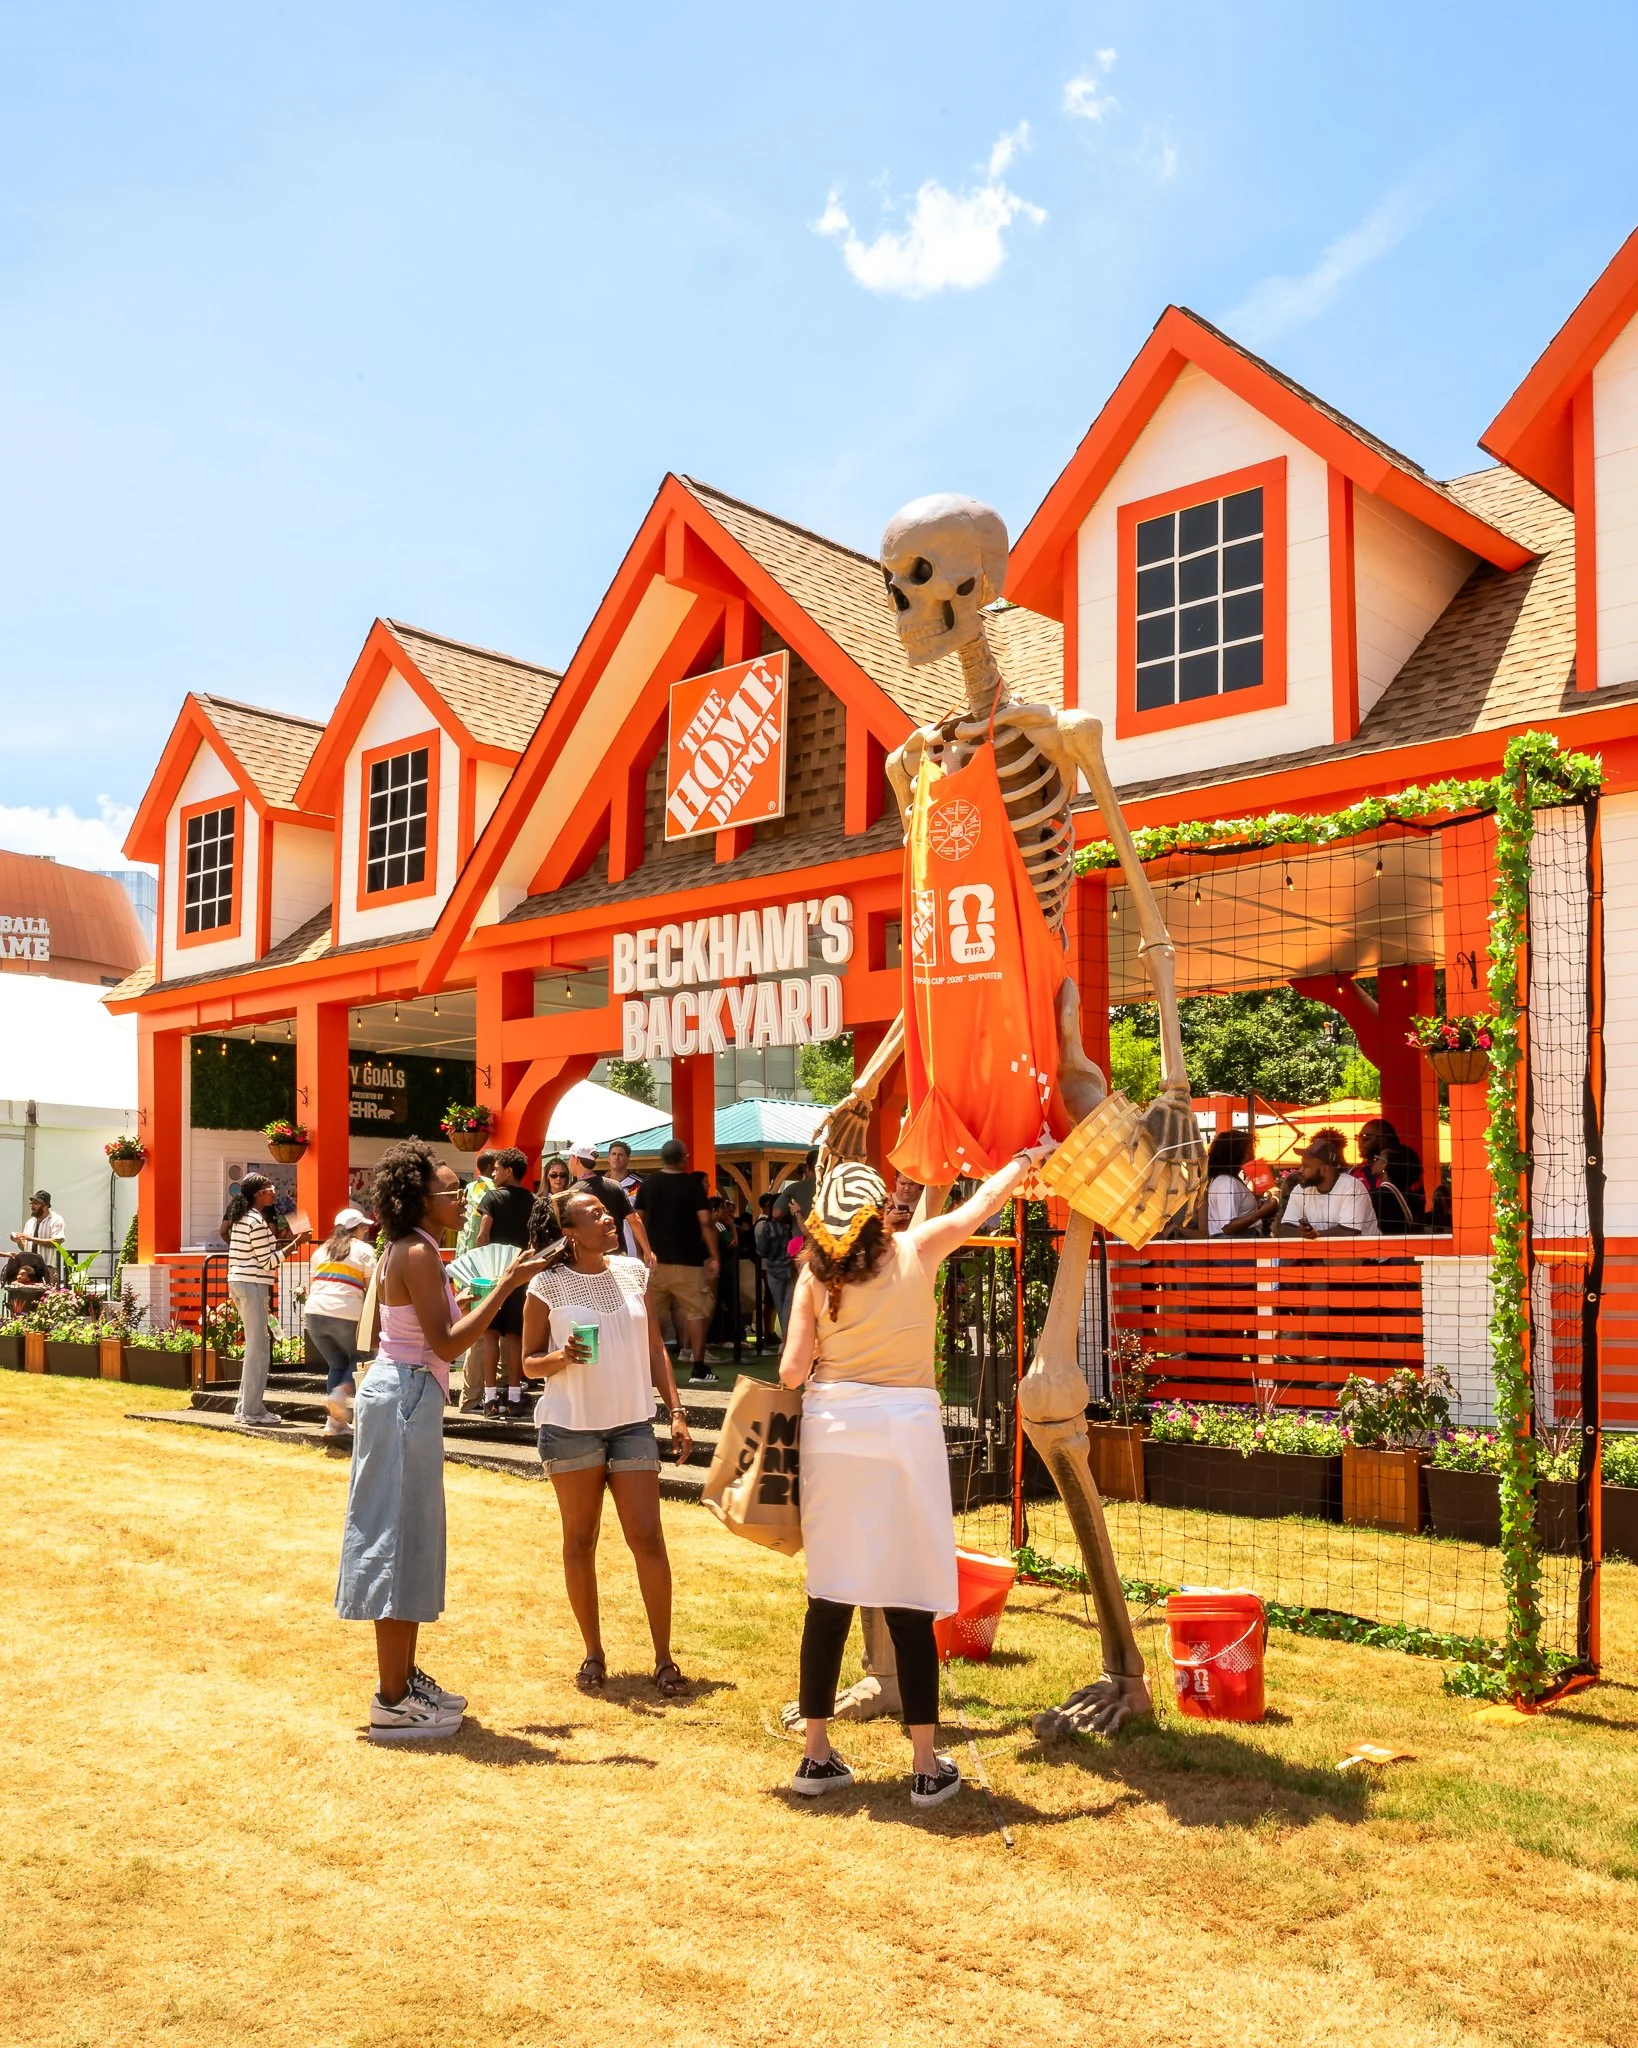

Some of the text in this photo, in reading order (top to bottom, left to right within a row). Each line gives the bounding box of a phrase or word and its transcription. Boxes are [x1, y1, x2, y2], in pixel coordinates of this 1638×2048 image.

[667, 658, 782, 833] HOME
[678, 688, 726, 756] THE
[708, 713, 781, 826] DEPOT
[613, 895, 854, 995] BECKHAM'S
[964, 946, 986, 956] FIFA
[931, 977, 945, 985] CUP
[622, 974, 843, 1062] BACKYARD
[349, 1101, 378, 1118] EHR
[363, 1067, 405, 1088] GOALS
